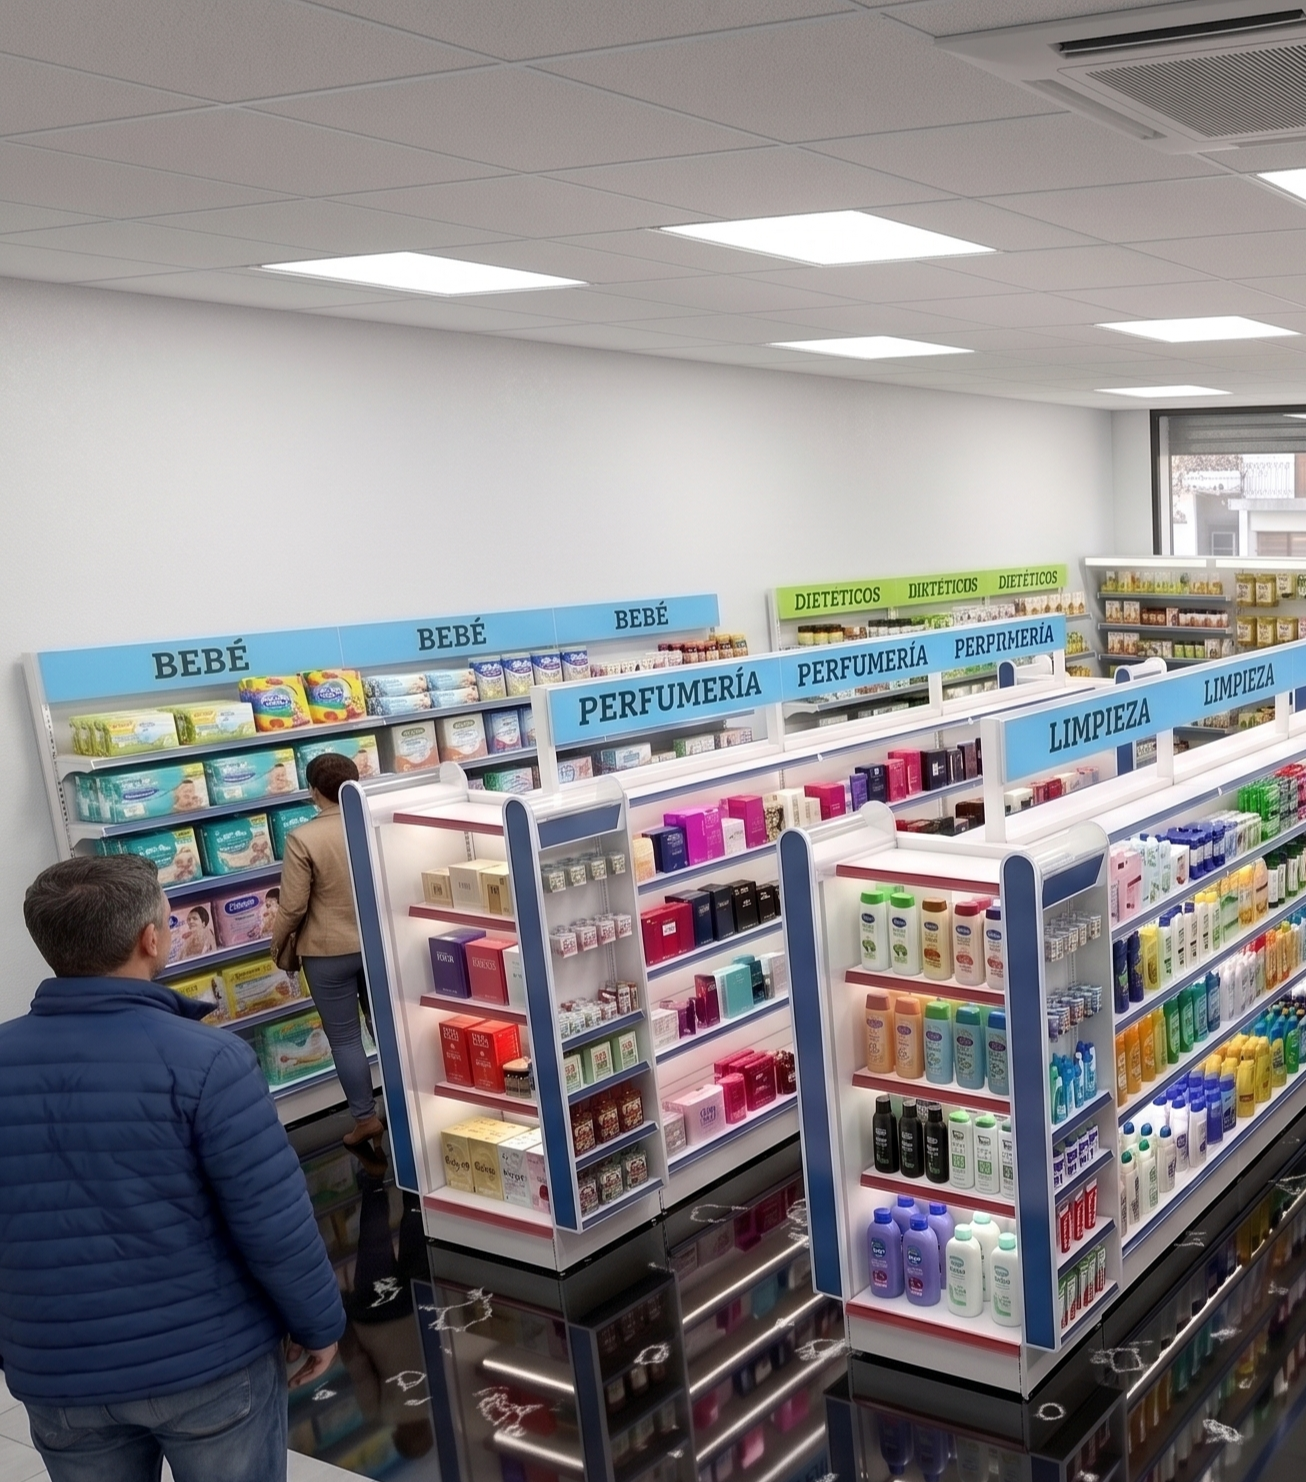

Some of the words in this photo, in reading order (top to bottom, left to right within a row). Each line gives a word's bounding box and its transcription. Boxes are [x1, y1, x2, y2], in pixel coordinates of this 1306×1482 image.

[999, 569, 1058, 590] DIETÉTICOS
[417, 617, 487, 651] BEBÉ
[614, 601, 669, 630] BEBÉ
[152, 638, 251, 680] BEBÉ
[798, 641, 928, 687] PERFUMERÍA
[579, 666, 762, 726] PERFUMERÍA
[1204, 663, 1275, 706] LIMPIEZA
[1049, 697, 1151, 753] LIMPIEZA
